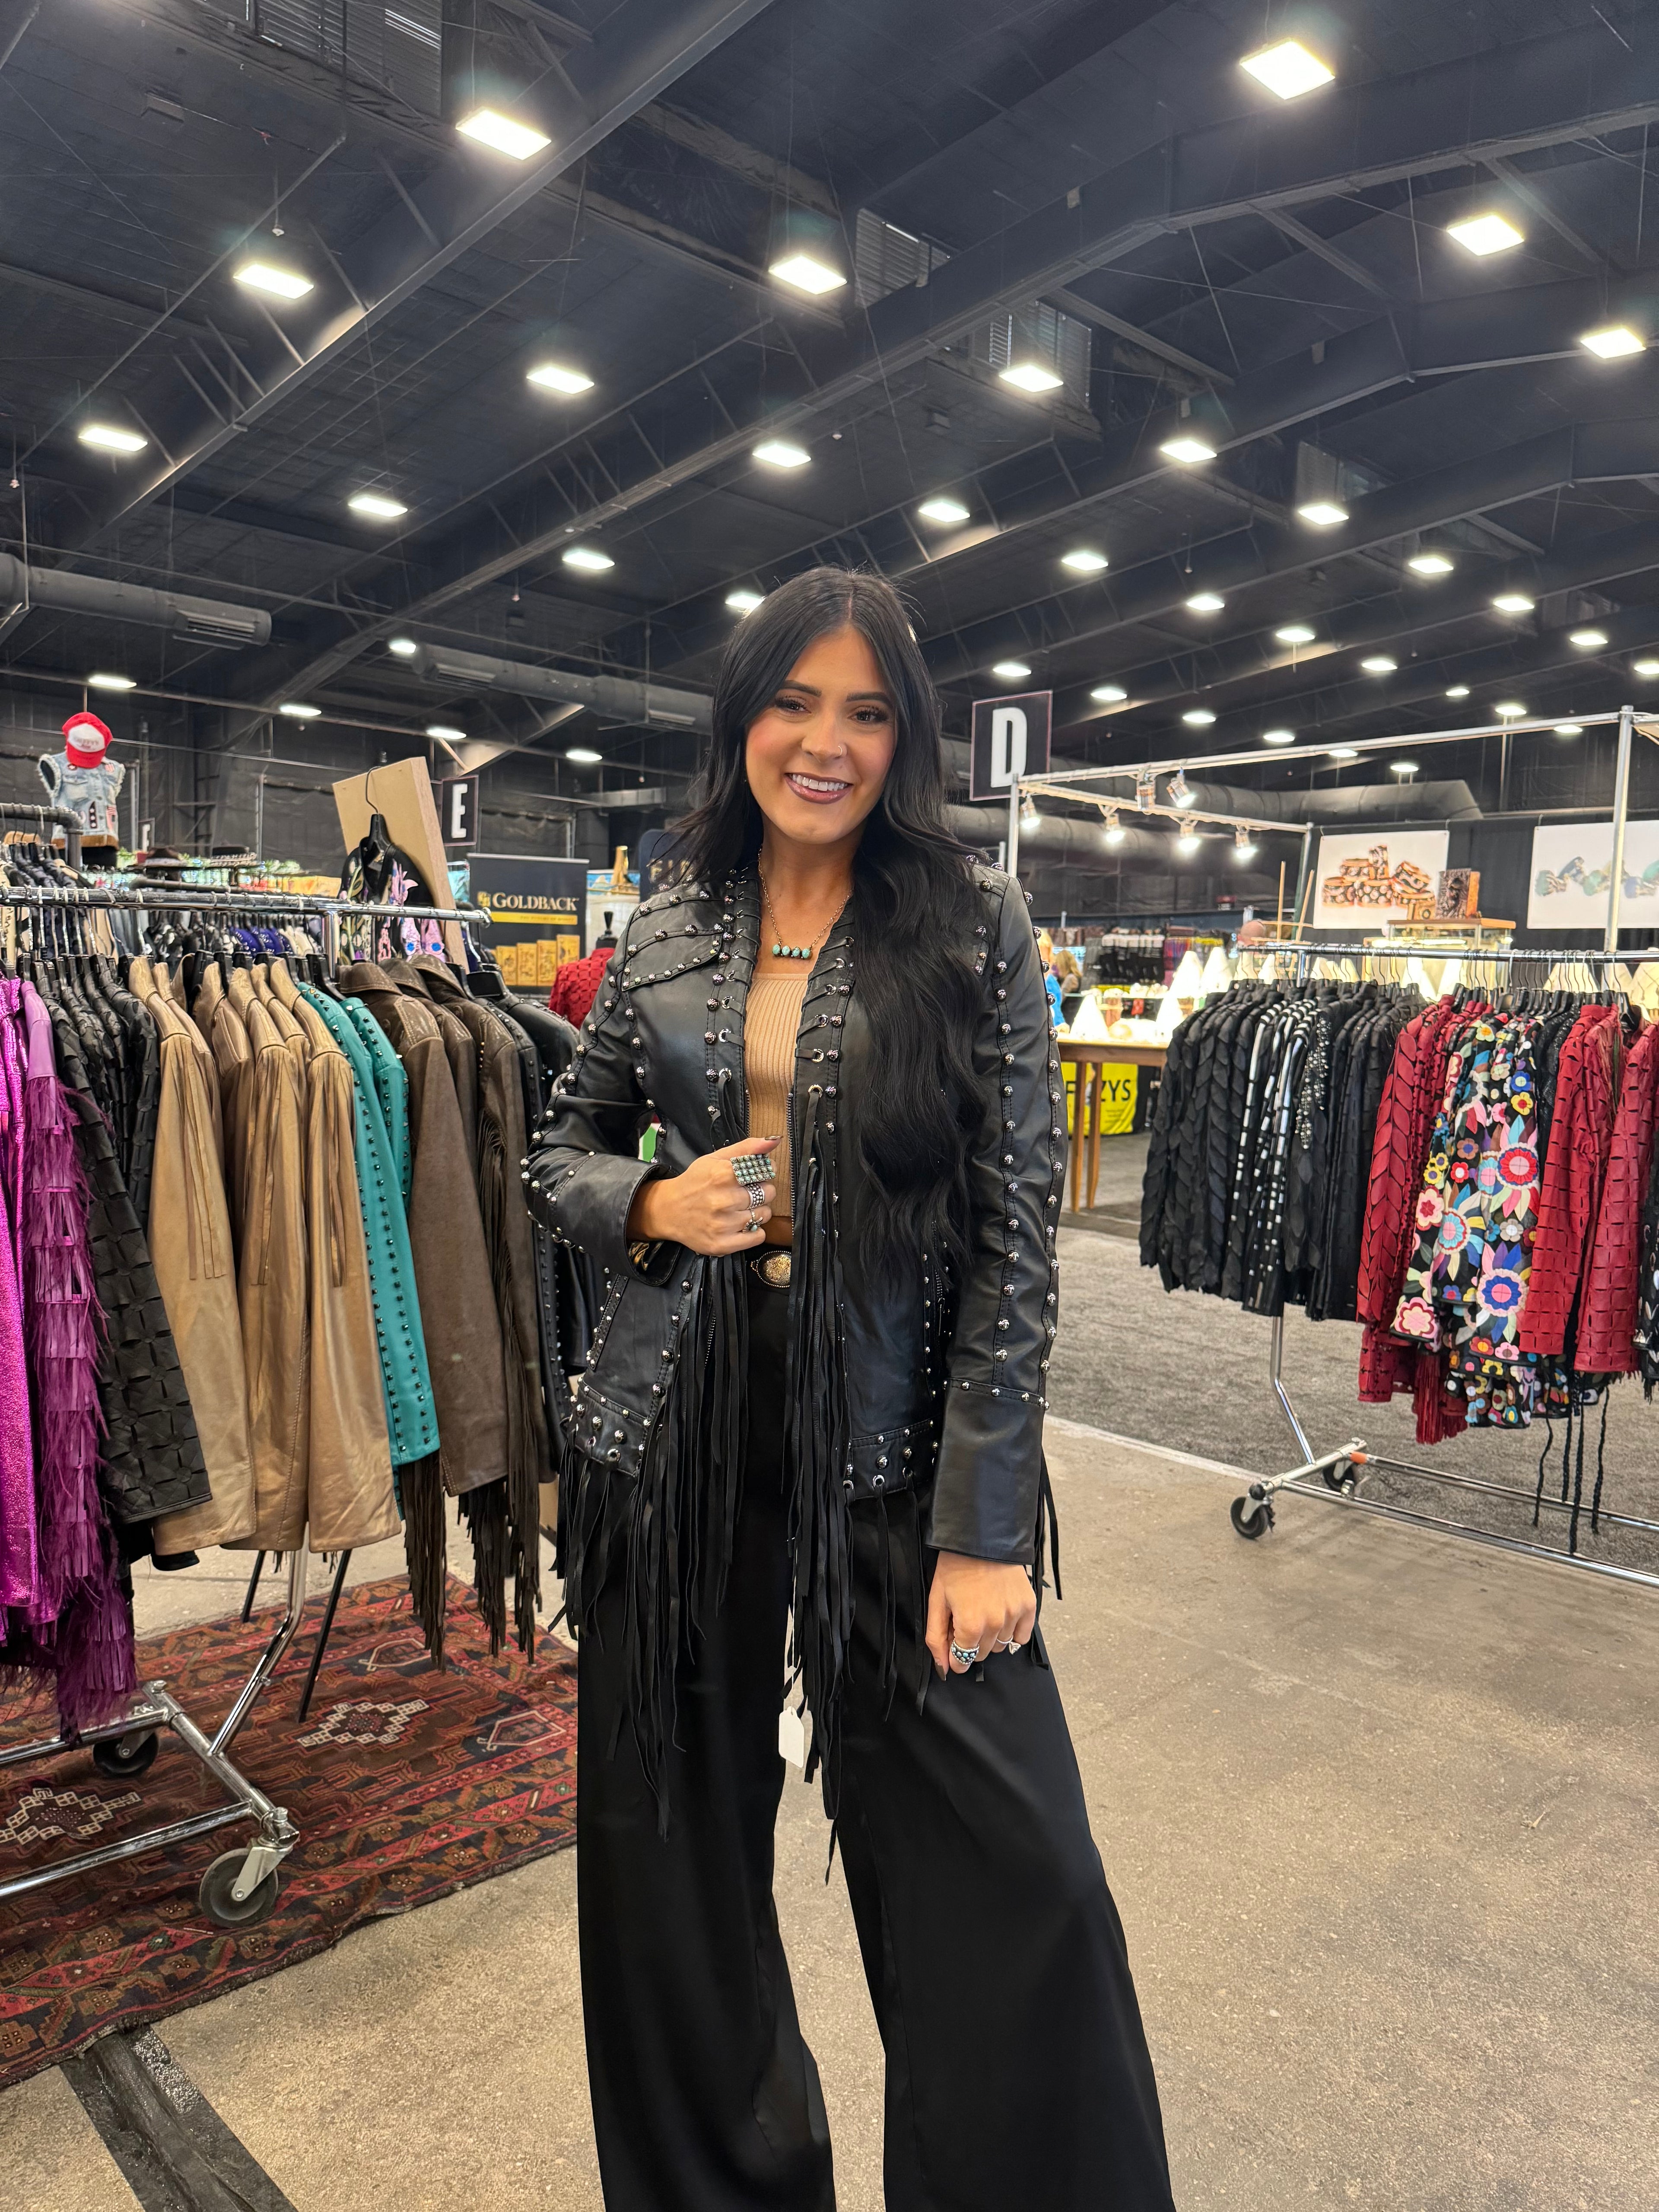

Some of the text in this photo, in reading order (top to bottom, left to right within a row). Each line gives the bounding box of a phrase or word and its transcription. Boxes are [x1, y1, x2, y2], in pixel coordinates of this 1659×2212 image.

[991, 707, 1027, 788] D
[451, 784, 467, 838] E
[492, 892, 578, 911] GOLDBACK
